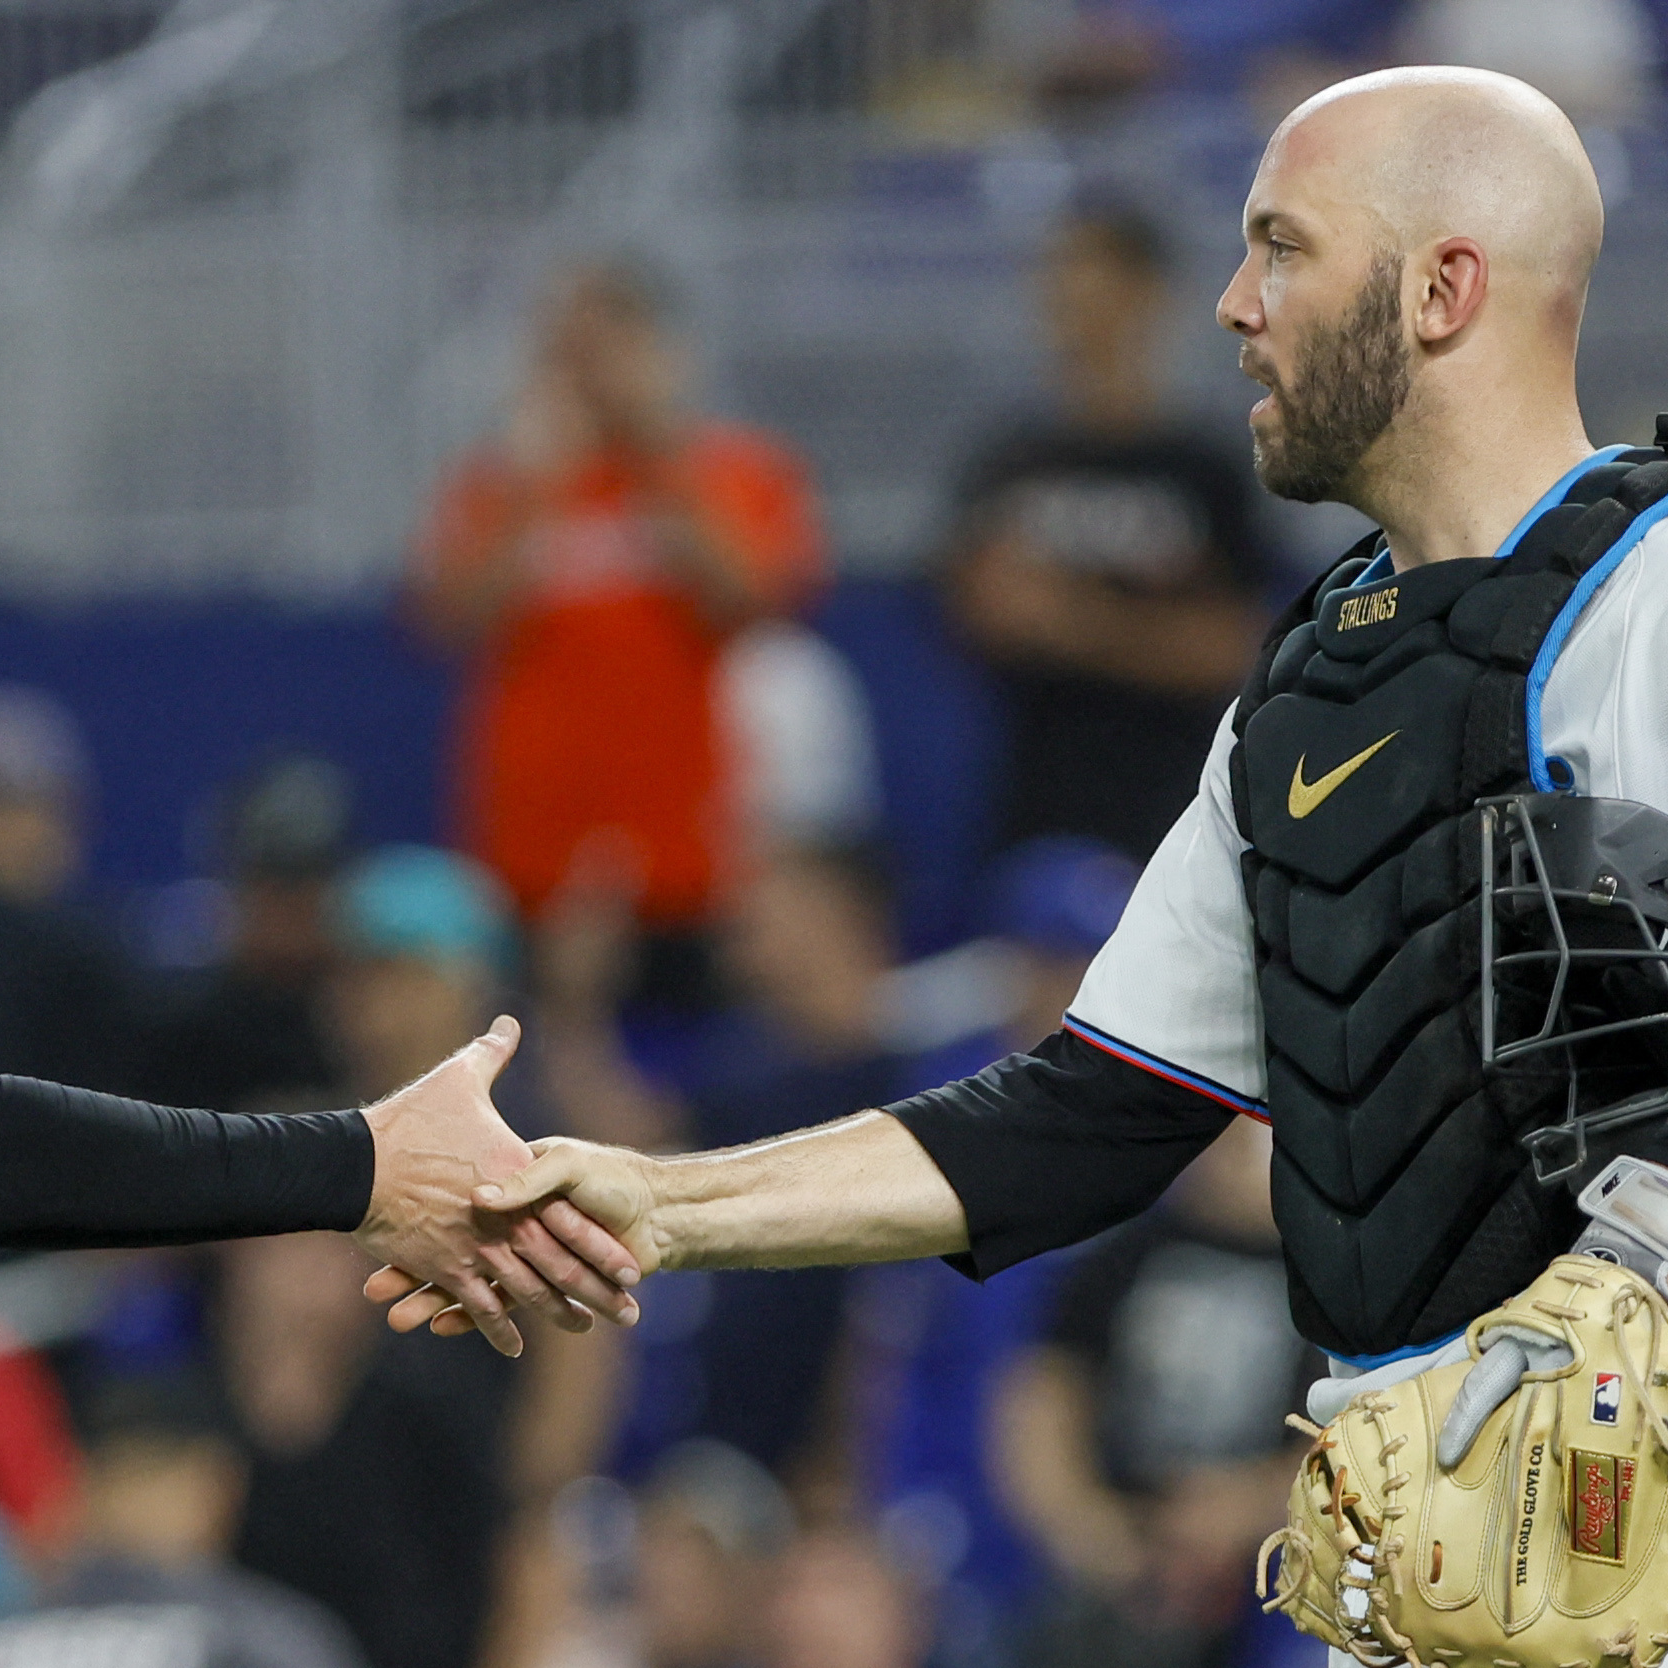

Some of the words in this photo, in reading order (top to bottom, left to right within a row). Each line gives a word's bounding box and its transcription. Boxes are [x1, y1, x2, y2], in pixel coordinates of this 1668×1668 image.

[1337, 586, 1400, 632] STALLINGS
[1601, 1172, 1621, 1198] NIKE
[1524, 1467, 1541, 1515] GLOVE
[1577, 1462, 1610, 1554] Rawlings
[1518, 1517, 1533, 1555] GOLD
[1516, 1556, 1528, 1587] THE
